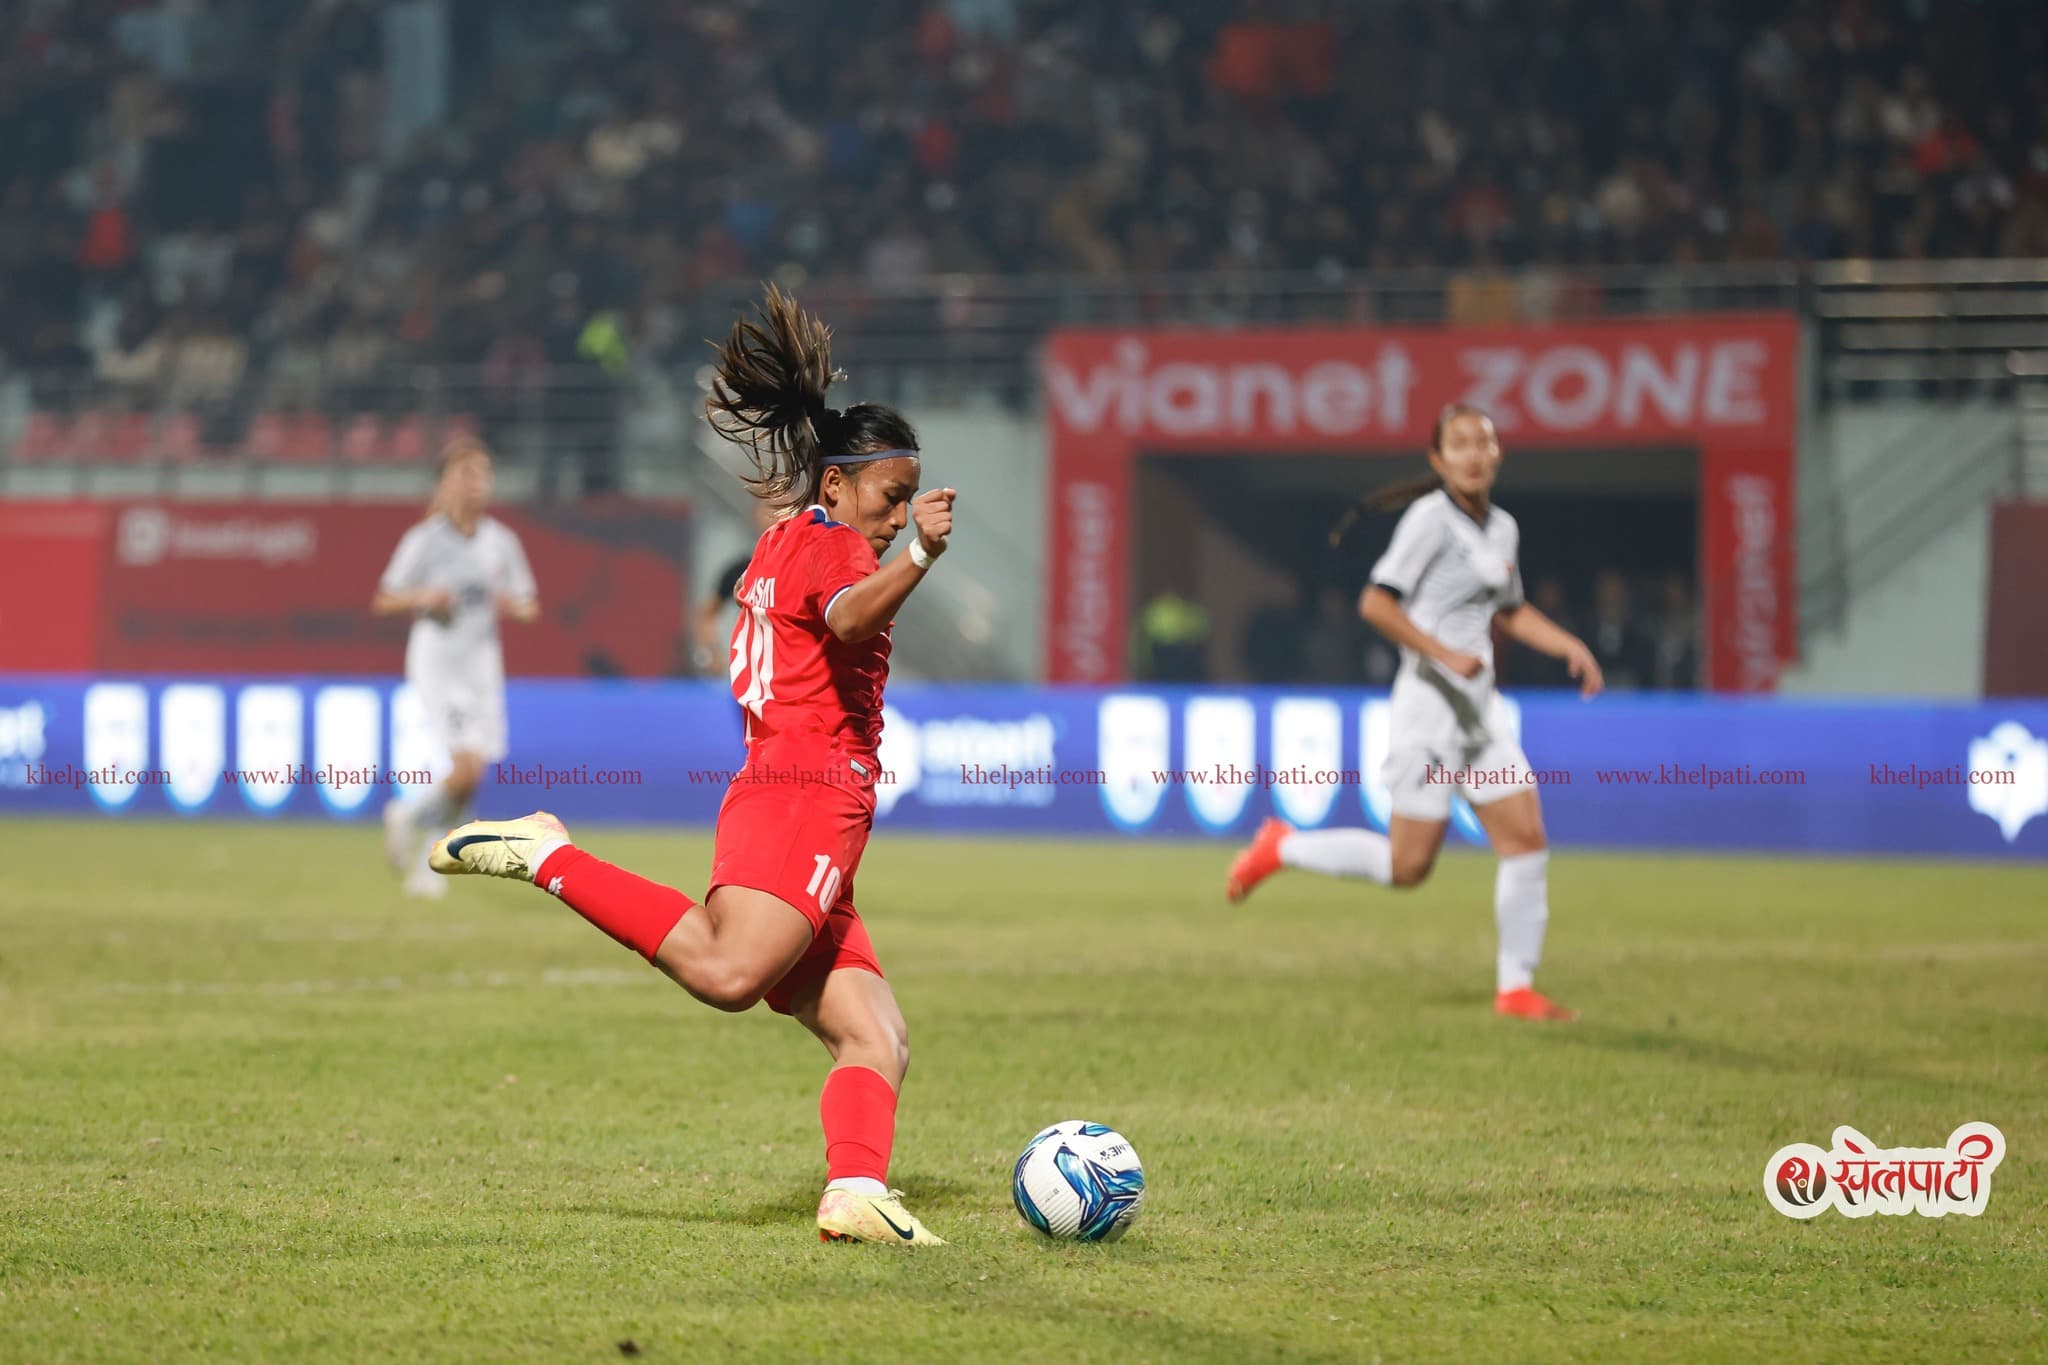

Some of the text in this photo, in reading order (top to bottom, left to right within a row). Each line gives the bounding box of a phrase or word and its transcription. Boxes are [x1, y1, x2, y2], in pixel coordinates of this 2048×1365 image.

[1048, 338, 1768, 434] vianet ZONE
[805, 854, 841, 913] 10
